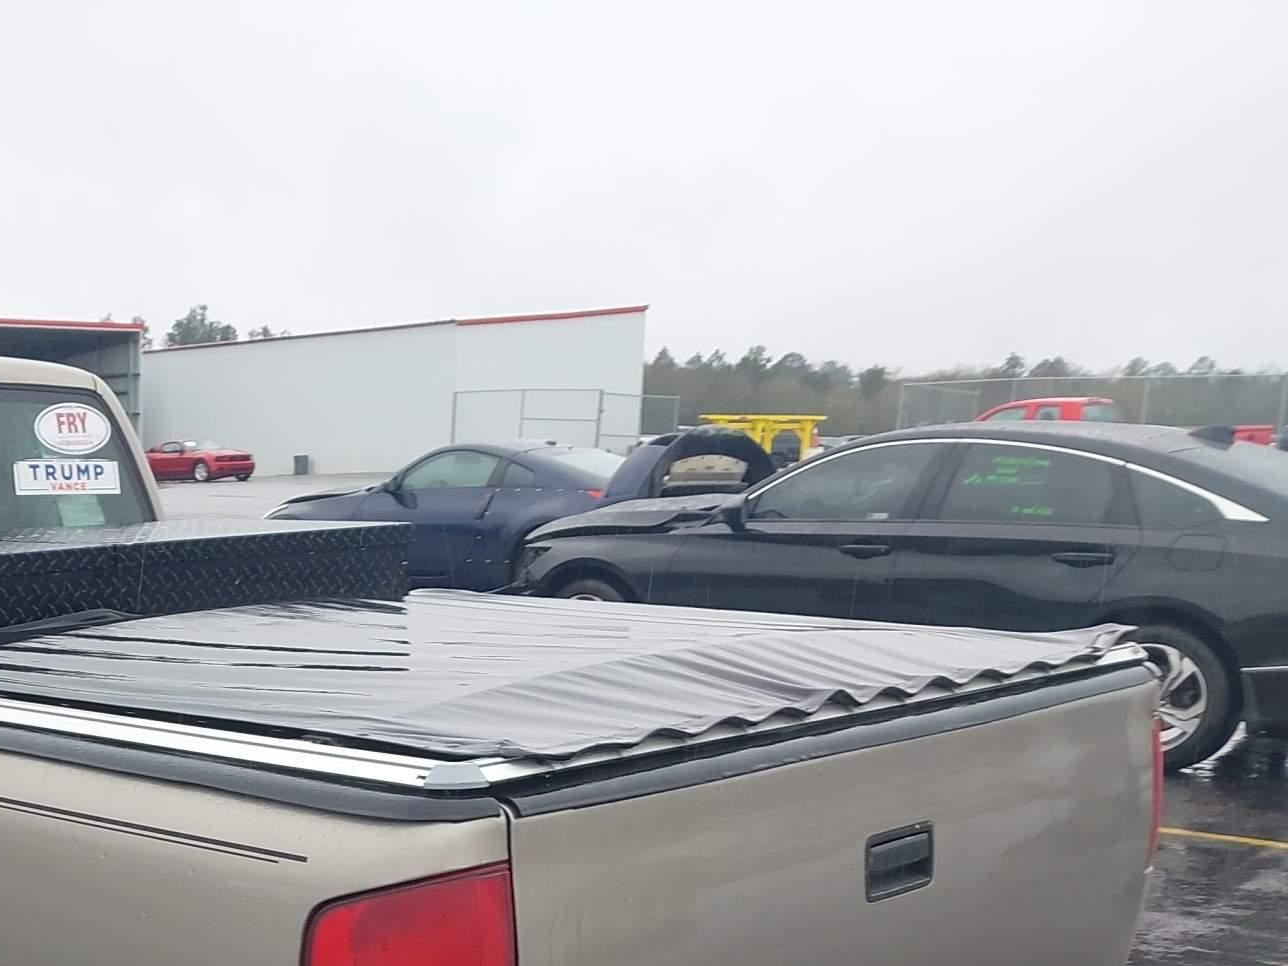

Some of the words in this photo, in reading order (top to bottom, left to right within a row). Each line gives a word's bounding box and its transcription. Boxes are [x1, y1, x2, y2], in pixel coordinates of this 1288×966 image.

[55, 412, 87, 434] FRY
[29, 464, 105, 481] TRUMP
[49, 482, 87, 491] VANCE
